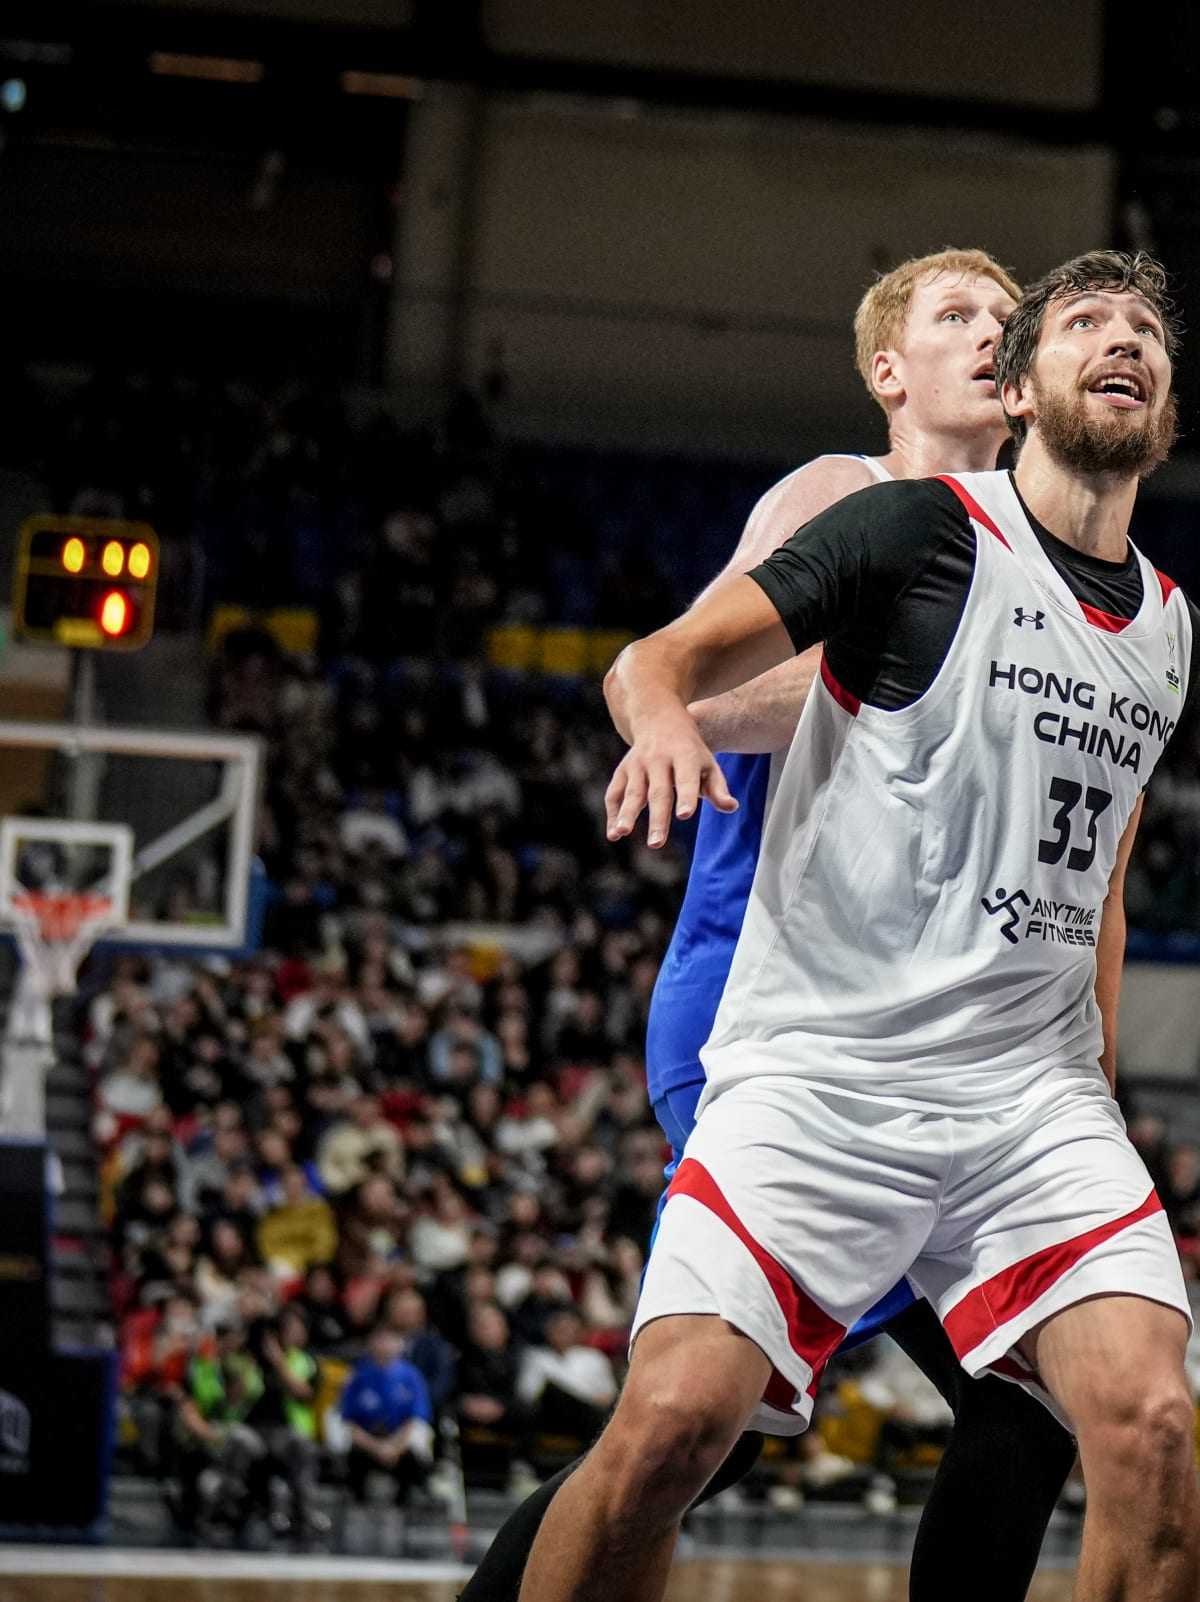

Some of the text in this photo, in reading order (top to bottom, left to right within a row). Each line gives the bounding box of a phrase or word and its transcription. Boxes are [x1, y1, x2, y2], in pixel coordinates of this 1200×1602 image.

[988, 660, 1096, 709] HONG
[1033, 711, 1141, 774] CHINA
[1037, 776, 1112, 872] 33
[1025, 920, 1096, 947] FITNESS
[1031, 897, 1096, 926] ANYTIME
